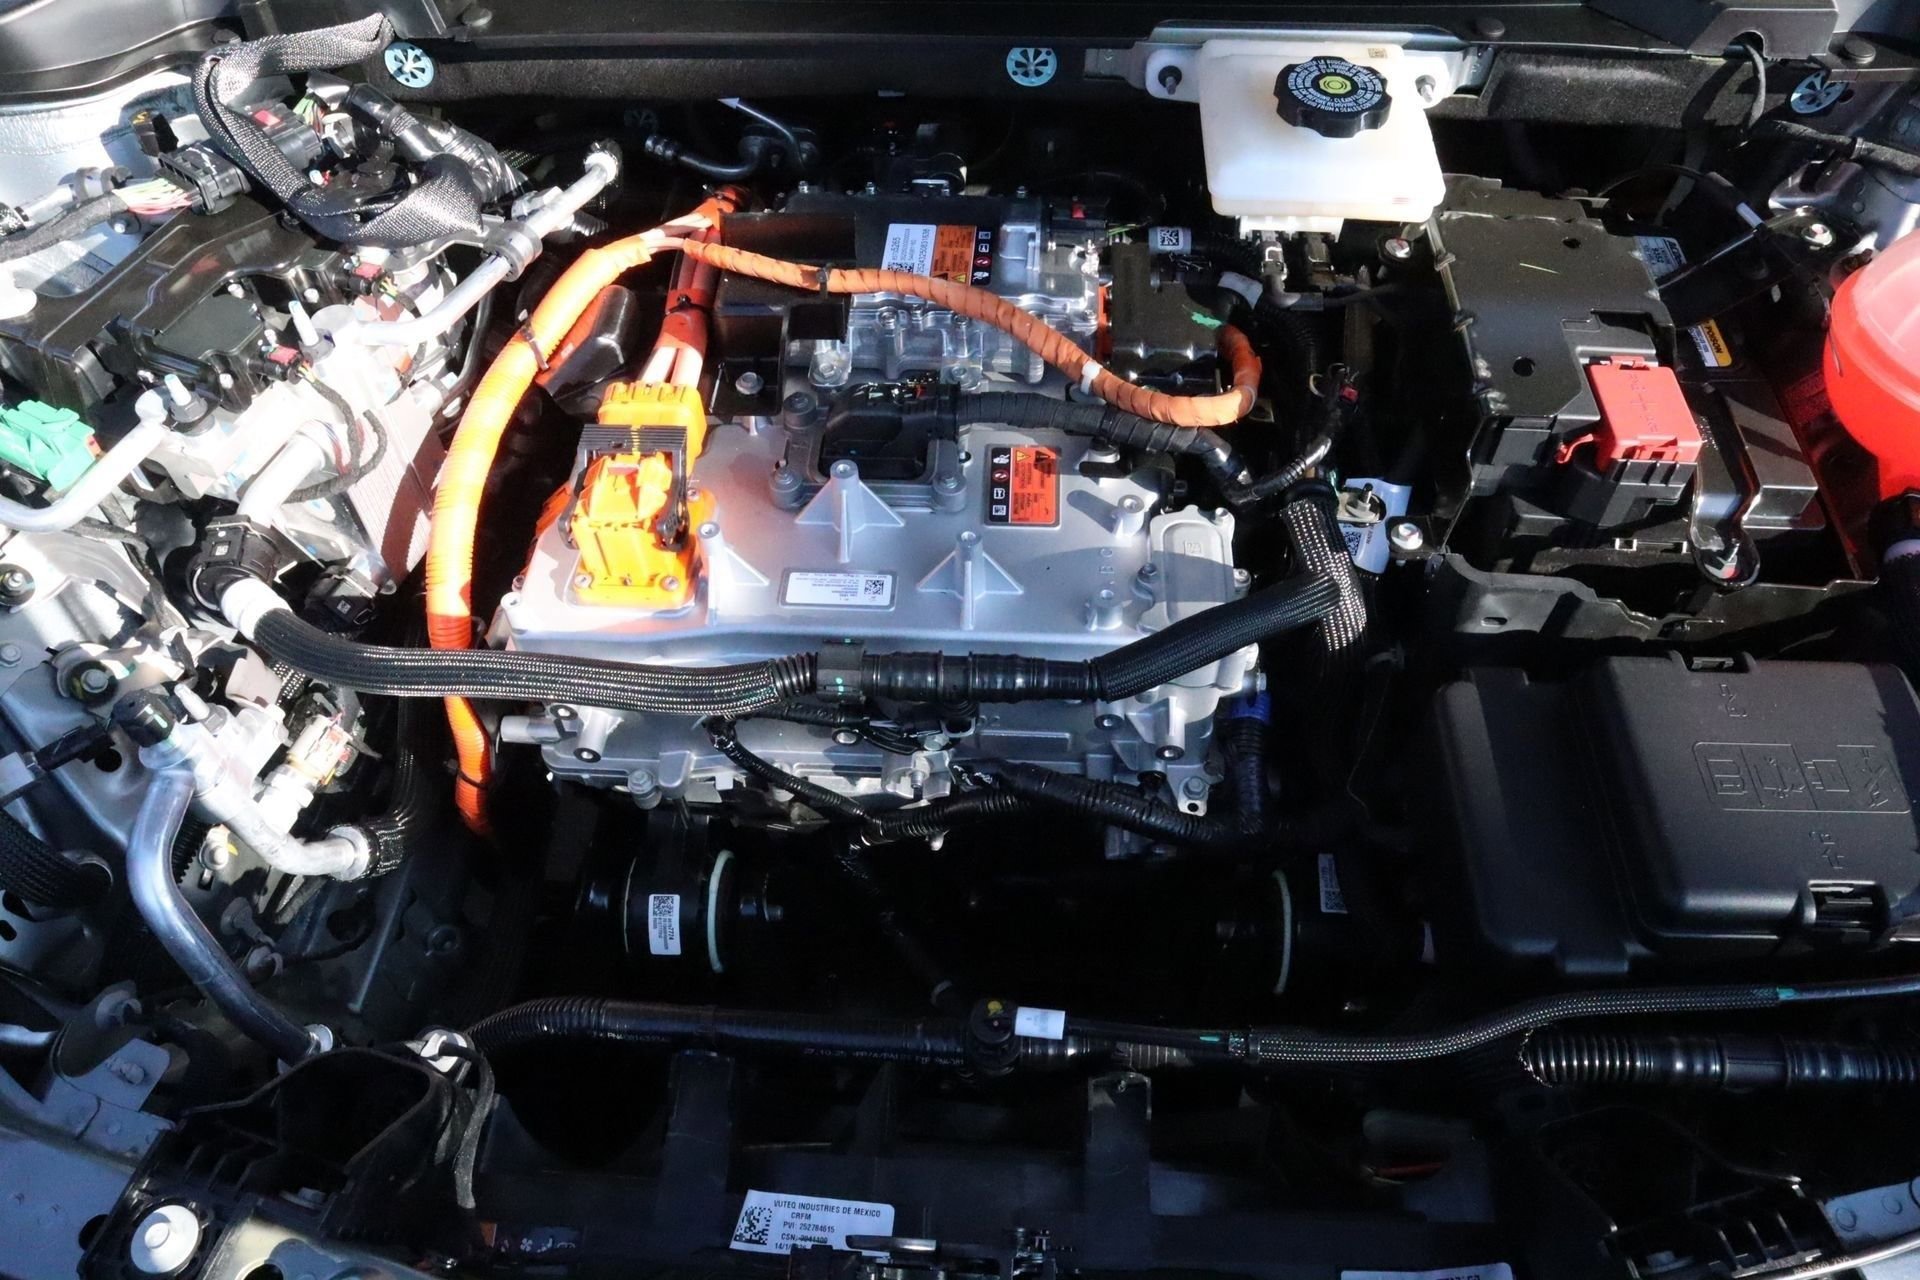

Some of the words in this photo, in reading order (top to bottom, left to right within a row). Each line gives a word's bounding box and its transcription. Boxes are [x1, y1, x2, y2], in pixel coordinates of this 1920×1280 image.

[1704, 326, 1723, 354] POISON
[774, 1199, 796, 1209] VUTEQ
[798, 1201, 841, 1214] INDUSTRIES
[842, 1206, 852, 1215] DE
[853, 1208, 881, 1218] MEXICO
[791, 1211, 812, 1220] CRFM
